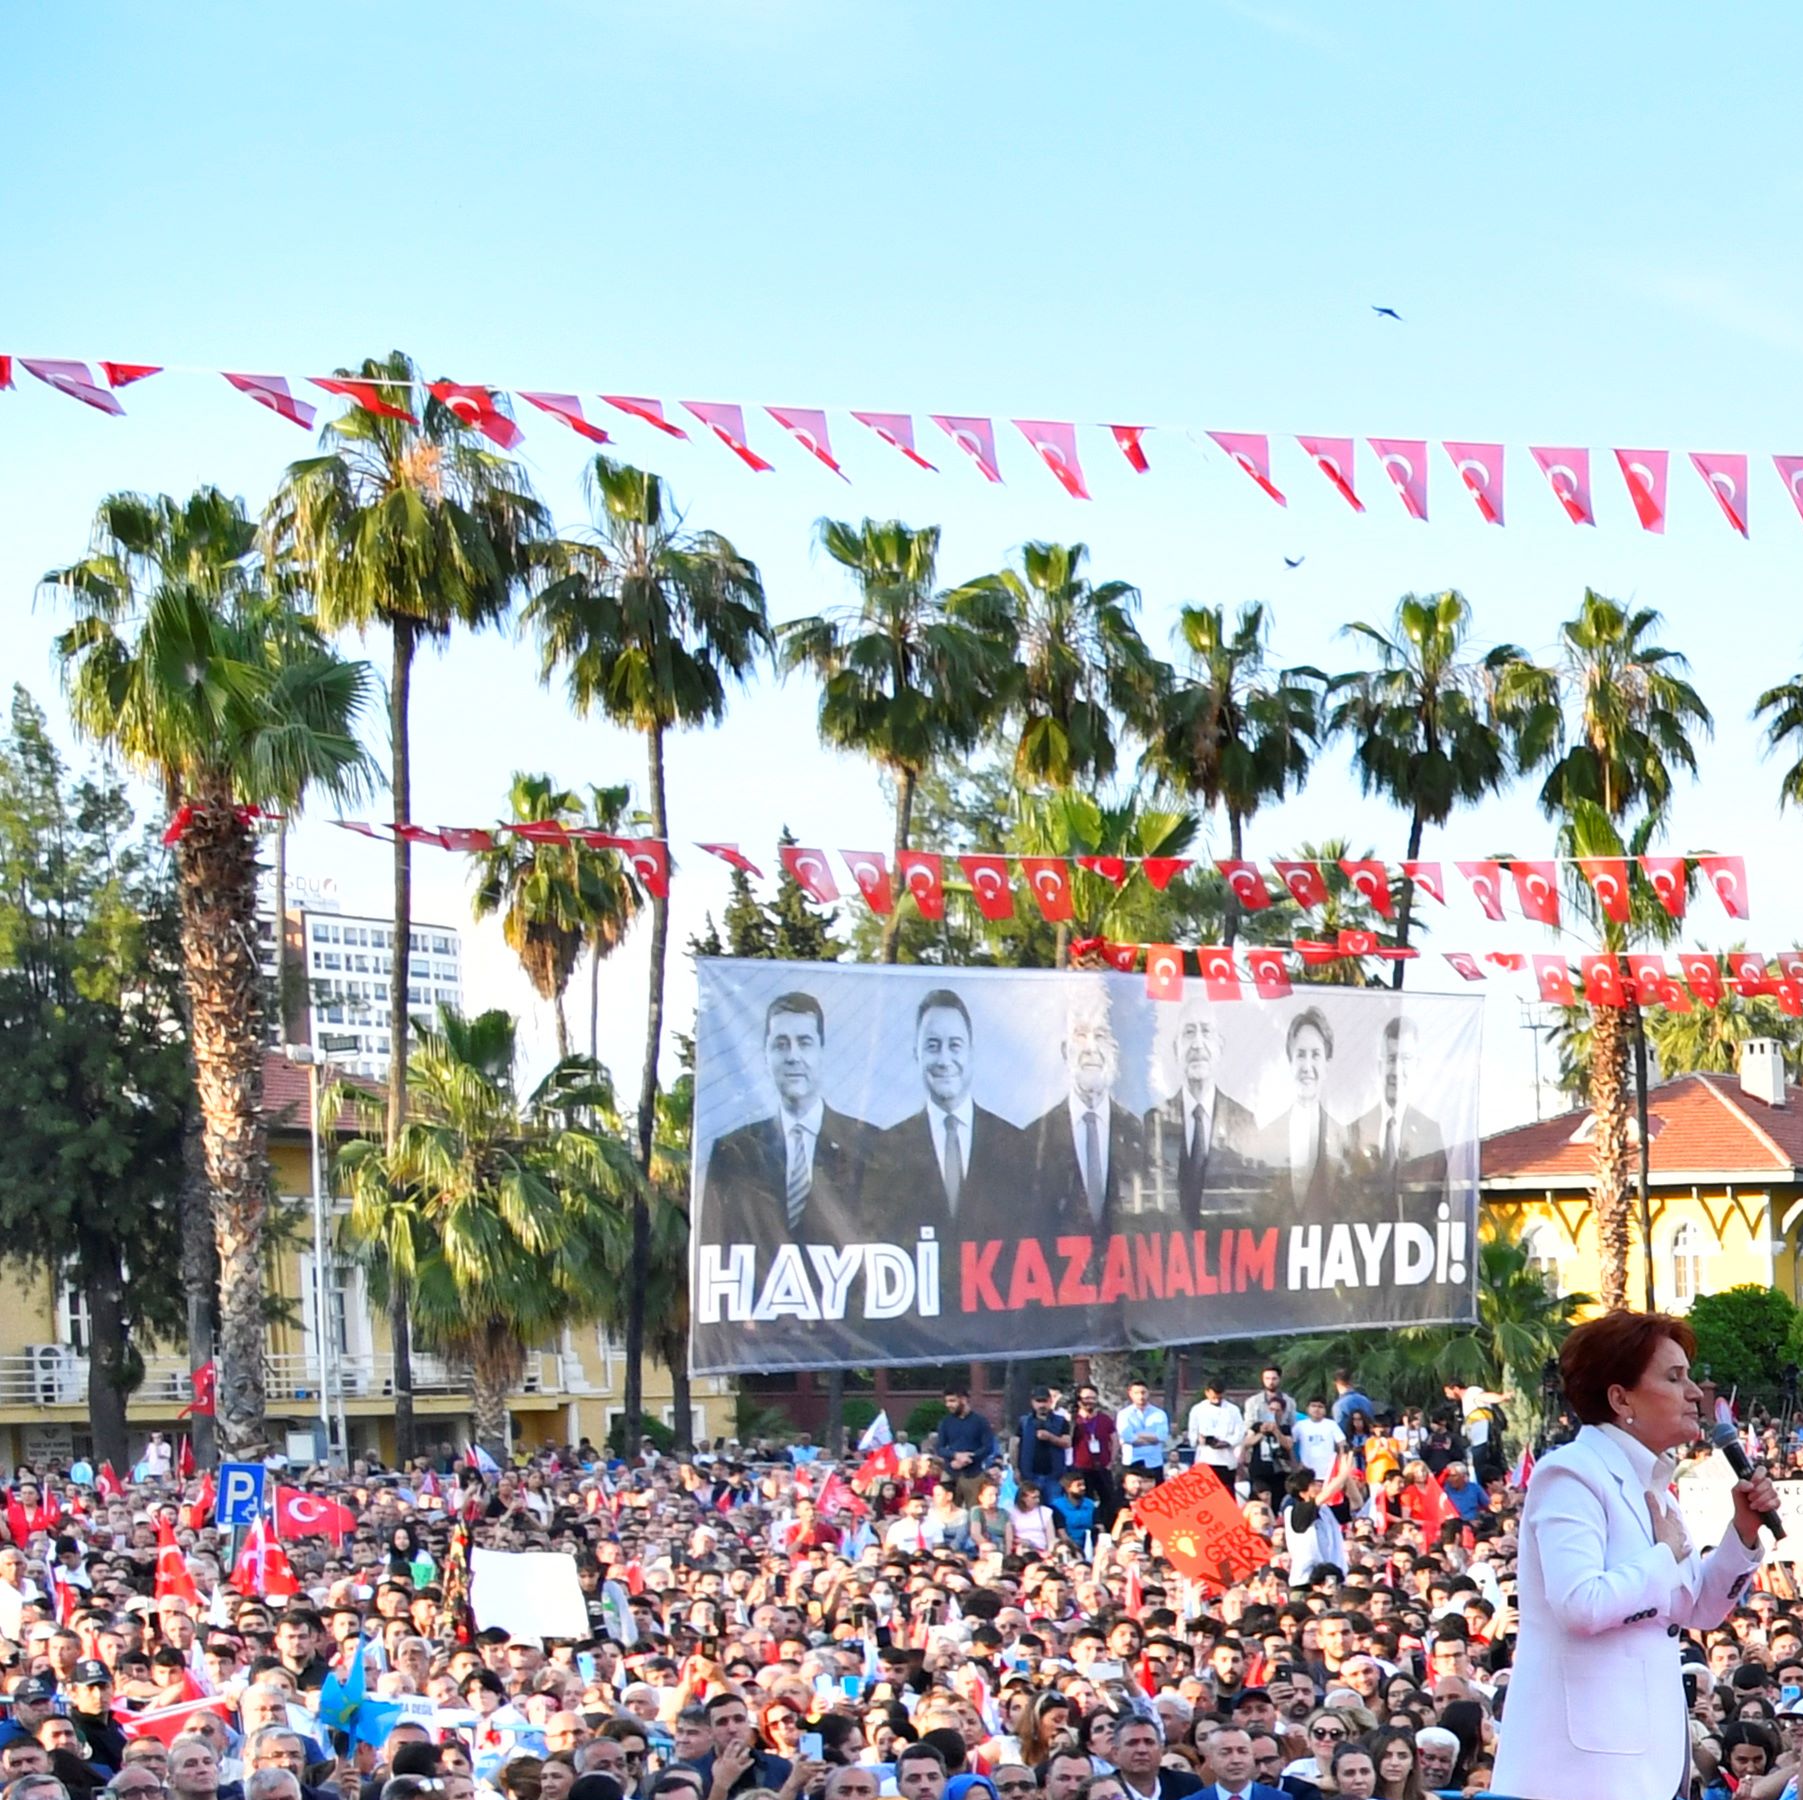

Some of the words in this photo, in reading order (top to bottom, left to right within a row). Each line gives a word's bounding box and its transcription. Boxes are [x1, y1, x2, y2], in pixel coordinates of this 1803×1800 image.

[699, 1226, 942, 1323] HAYDİ
[960, 1227, 1277, 1315] KAZANALIM
[1286, 1202, 1468, 1292] HAYDİ!
